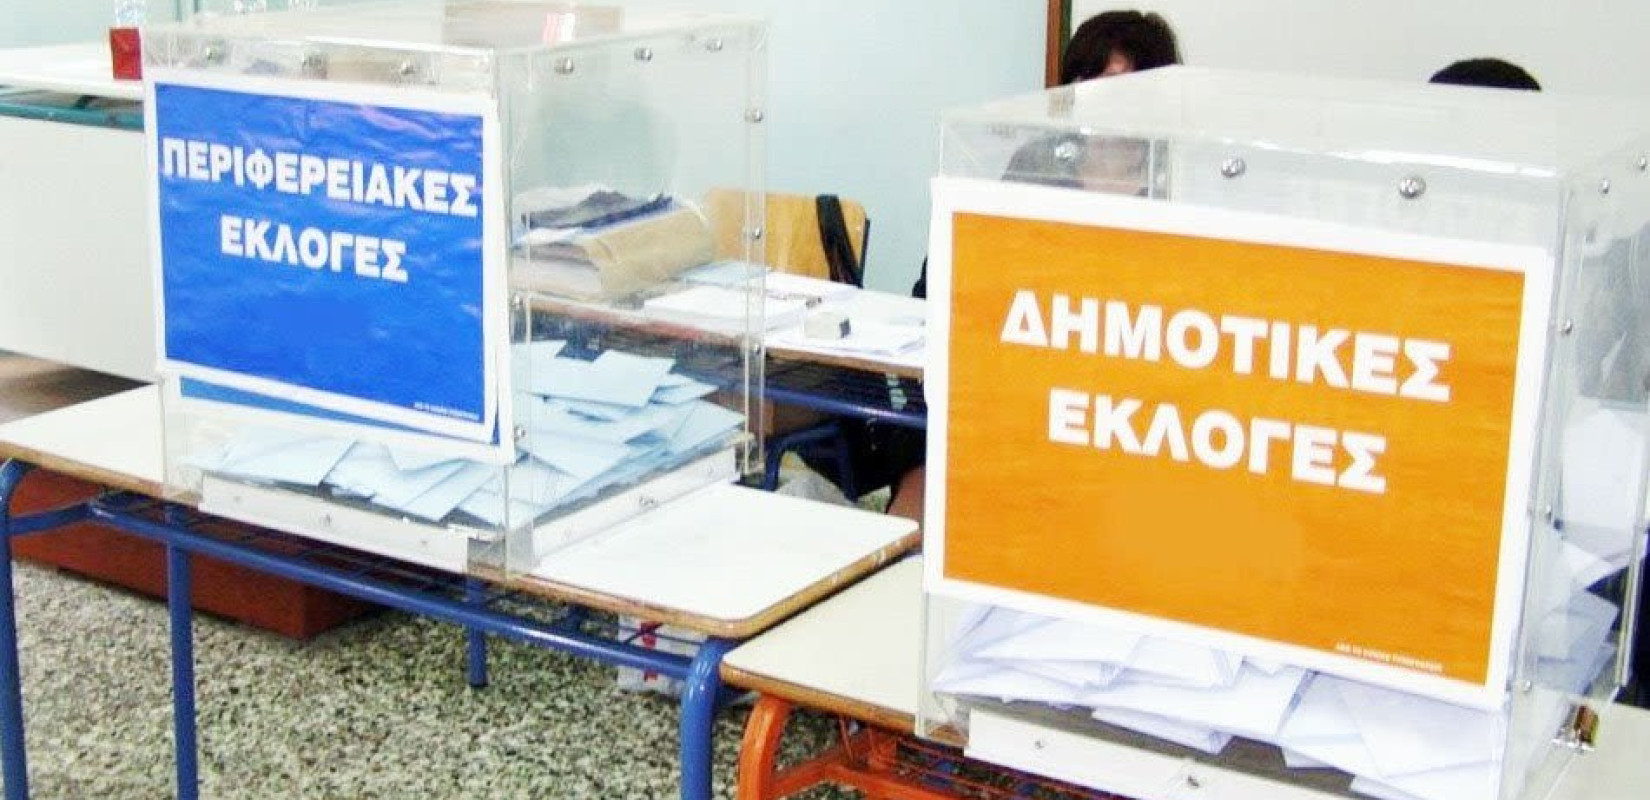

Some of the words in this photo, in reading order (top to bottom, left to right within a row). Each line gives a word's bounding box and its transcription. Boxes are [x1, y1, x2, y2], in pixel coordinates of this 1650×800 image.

[161, 137, 478, 217] ΠΕΡΙΦΕΡΕΙΑΚΕΣ
[220, 214, 408, 283] ΕΚΛΟΓΕΣ
[1000, 290, 1451, 402] ΔΗΜΟΤΙΚΕΣ
[1048, 388, 1388, 494] ΕΚΛΟΓΕΣ
